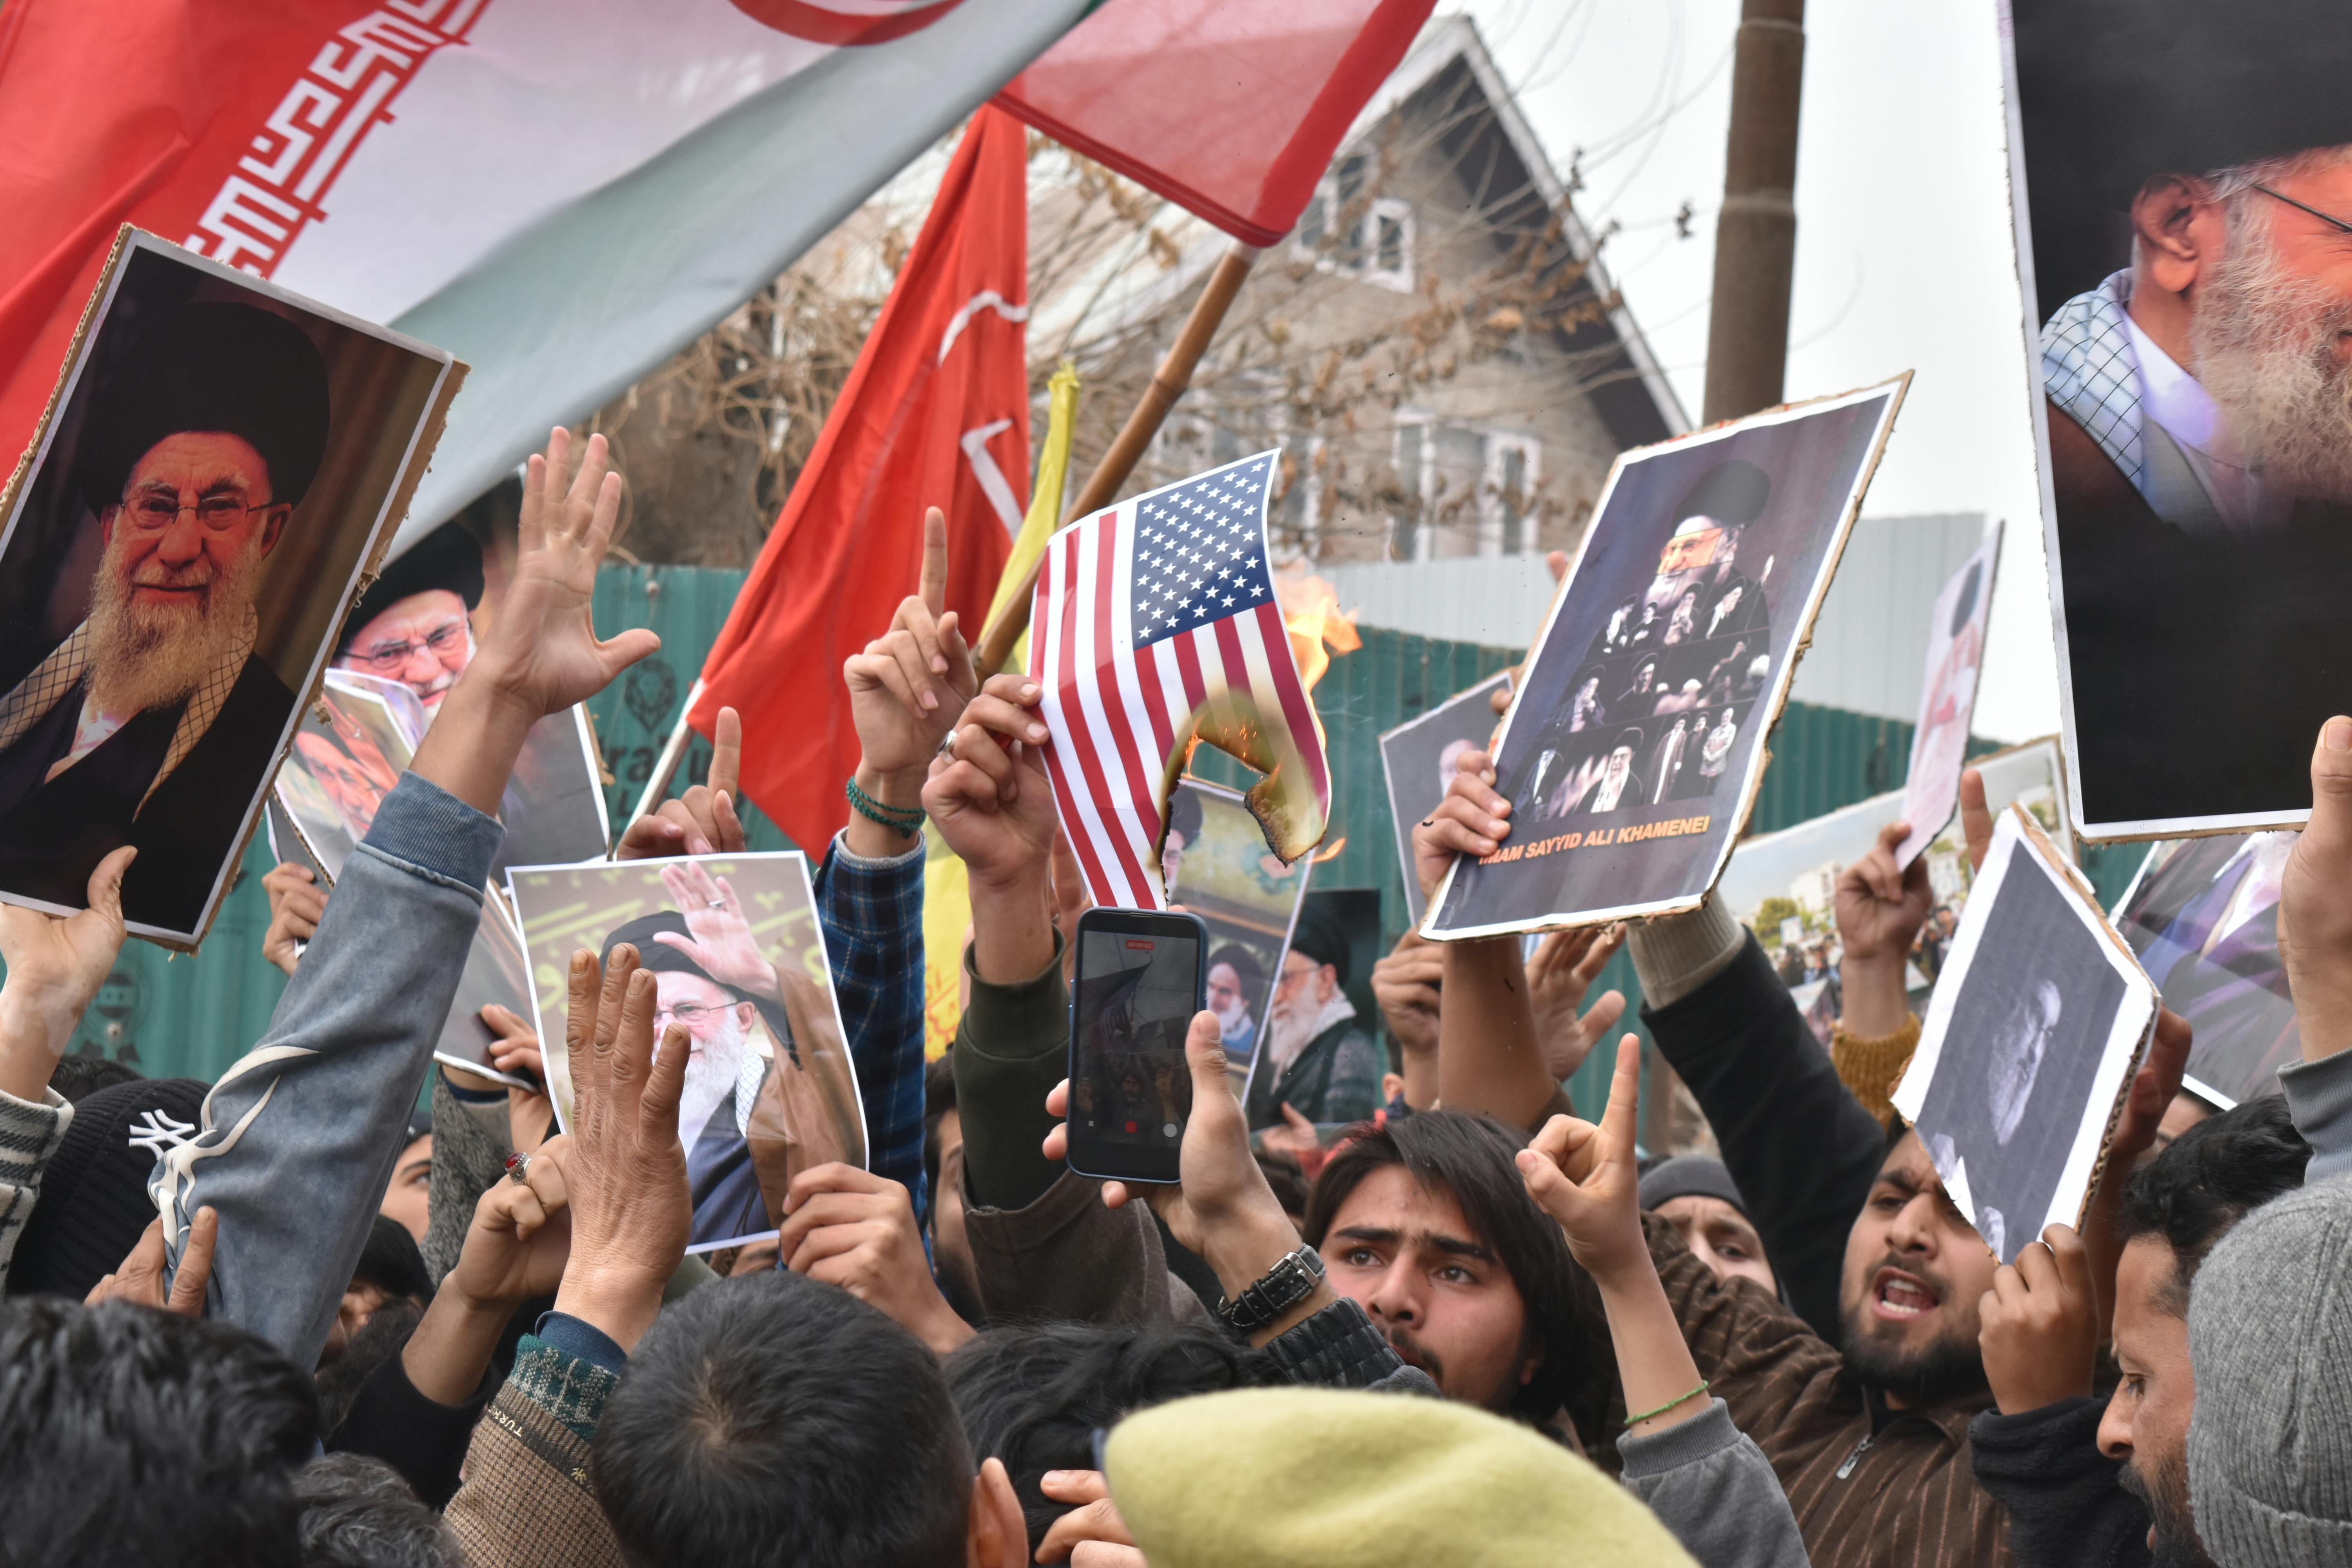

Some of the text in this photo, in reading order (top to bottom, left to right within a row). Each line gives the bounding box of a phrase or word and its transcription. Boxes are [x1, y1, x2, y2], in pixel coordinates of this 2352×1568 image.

[1525, 833, 1581, 858] SAYYID
[1583, 829, 1615, 847] ALI
[1616, 816, 1711, 843] KHAMENEI
